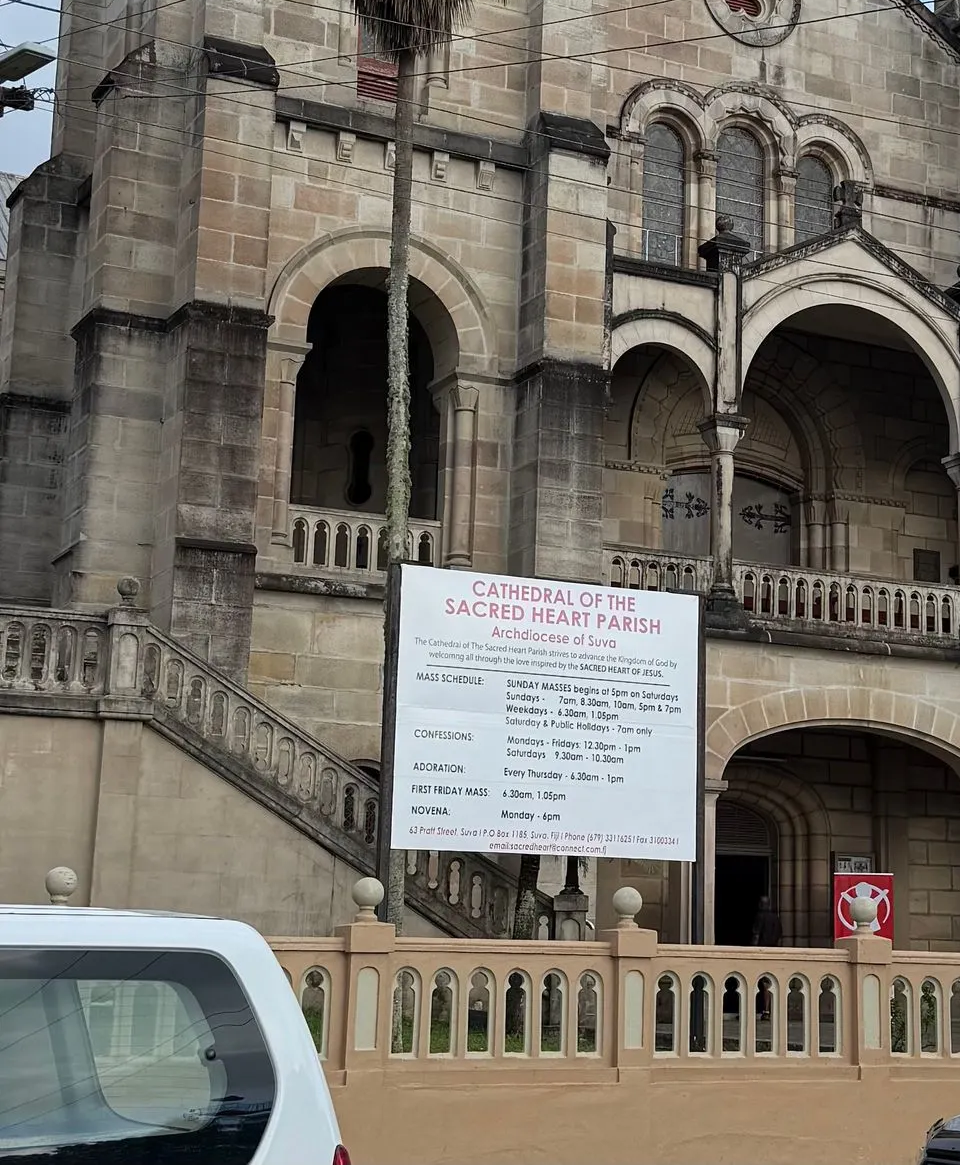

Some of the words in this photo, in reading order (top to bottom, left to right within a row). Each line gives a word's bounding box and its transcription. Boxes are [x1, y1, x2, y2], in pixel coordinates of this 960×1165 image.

[472, 580, 574, 606] CATHEDRAL
[580, 592, 602, 608] OF
[608, 595, 636, 612] THE
[445, 598, 525, 621] SACRED
[532, 607, 590, 628] HEART
[597, 614, 661, 635] PARISH
[492, 626, 569, 644] Archdiocese
[574, 634, 585, 646] of
[588, 635, 616, 649] Suva
[415, 637, 427, 646] The
[428, 638, 461, 649] Cathedral
[462, 641, 470, 650] of
[471, 642, 484, 651] The
[485, 643, 507, 653] Sacred
[508, 645, 527, 655] Heart
[528, 647, 547, 657] Parish
[549, 650, 569, 659] strives
[579, 652, 605, 662] advance
[606, 654, 617, 663] the
[618, 655, 646, 667] Kingdom
[647, 657, 655, 666] of
[655, 659, 669, 668] God
[670, 660, 678, 670] by
[466, 653, 474, 661] all
[475, 653, 502, 665] through
[503, 656, 515, 665] the
[516, 657, 530, 666] love
[530, 659, 557, 670] inspired
[558, 661, 567, 671] by
[568, 662, 579, 671] the
[579, 663, 607, 673] SACRED
[608, 665, 630, 675] HEART
[631, 667, 641, 676] OF
[642, 668, 664, 678] JESUS.
[416, 672, 439, 682] MASS
[441, 673, 485, 686] SCHEDULE:
[507, 679, 539, 690] SUNDAY
[541, 682, 571, 693] MASSES
[574, 684, 599, 696] begins
[602, 687, 609, 696] at
[611, 687, 628, 699] 5pm
[630, 690, 640, 699] on
[642, 690, 679, 702] Saturdays
[506, 691, 540, 703] Sundays
[559, 696, 578, 707] 7am,
[638, 702, 655, 713] 5pm
[657, 704, 663, 712] &
[665, 704, 682, 715] 7pm
[506, 704, 548, 717] Weekdays
[591, 710, 619, 722] 1.05pm
[414, 729, 474, 741] CONFESSIONS:
[505, 716, 540, 729] Saturday
[543, 719, 548, 728] &
[551, 720, 574, 730] Public
[576, 722, 610, 734] Holidays
[617, 724, 634, 735] 7am
[636, 727, 653, 737] only
[507, 736, 544, 748] Mondays
[584, 740, 616, 752] 12.30pm
[624, 743, 641, 754] 1pm
[506, 748, 546, 760] Saturdays
[554, 751, 583, 762] 9.30am
[592, 753, 624, 764] 10.30am
[413, 762, 466, 774] ADORATION:
[504, 767, 525, 779] Every
[528, 769, 562, 782] Thursday
[570, 772, 599, 782] 6.30am
[607, 774, 624, 784] 1pm
[411, 784, 431, 795] FIRST
[434, 785, 463, 796] FRIDAY
[465, 787, 490, 797] MASS:
[502, 789, 534, 801] 6.30am,
[537, 791, 566, 802] 1.05pm
[411, 805, 450, 816] NOVENA:
[501, 810, 535, 822] Monday
[542, 812, 560, 823] 6pm
[409, 825, 418, 835] 63
[420, 826, 436, 835] Pratt
[460, 827, 478, 837] Suva
[497, 829, 509, 838] Box
[564, 832, 585, 841] Phone
[636, 835, 647, 844] Fax
